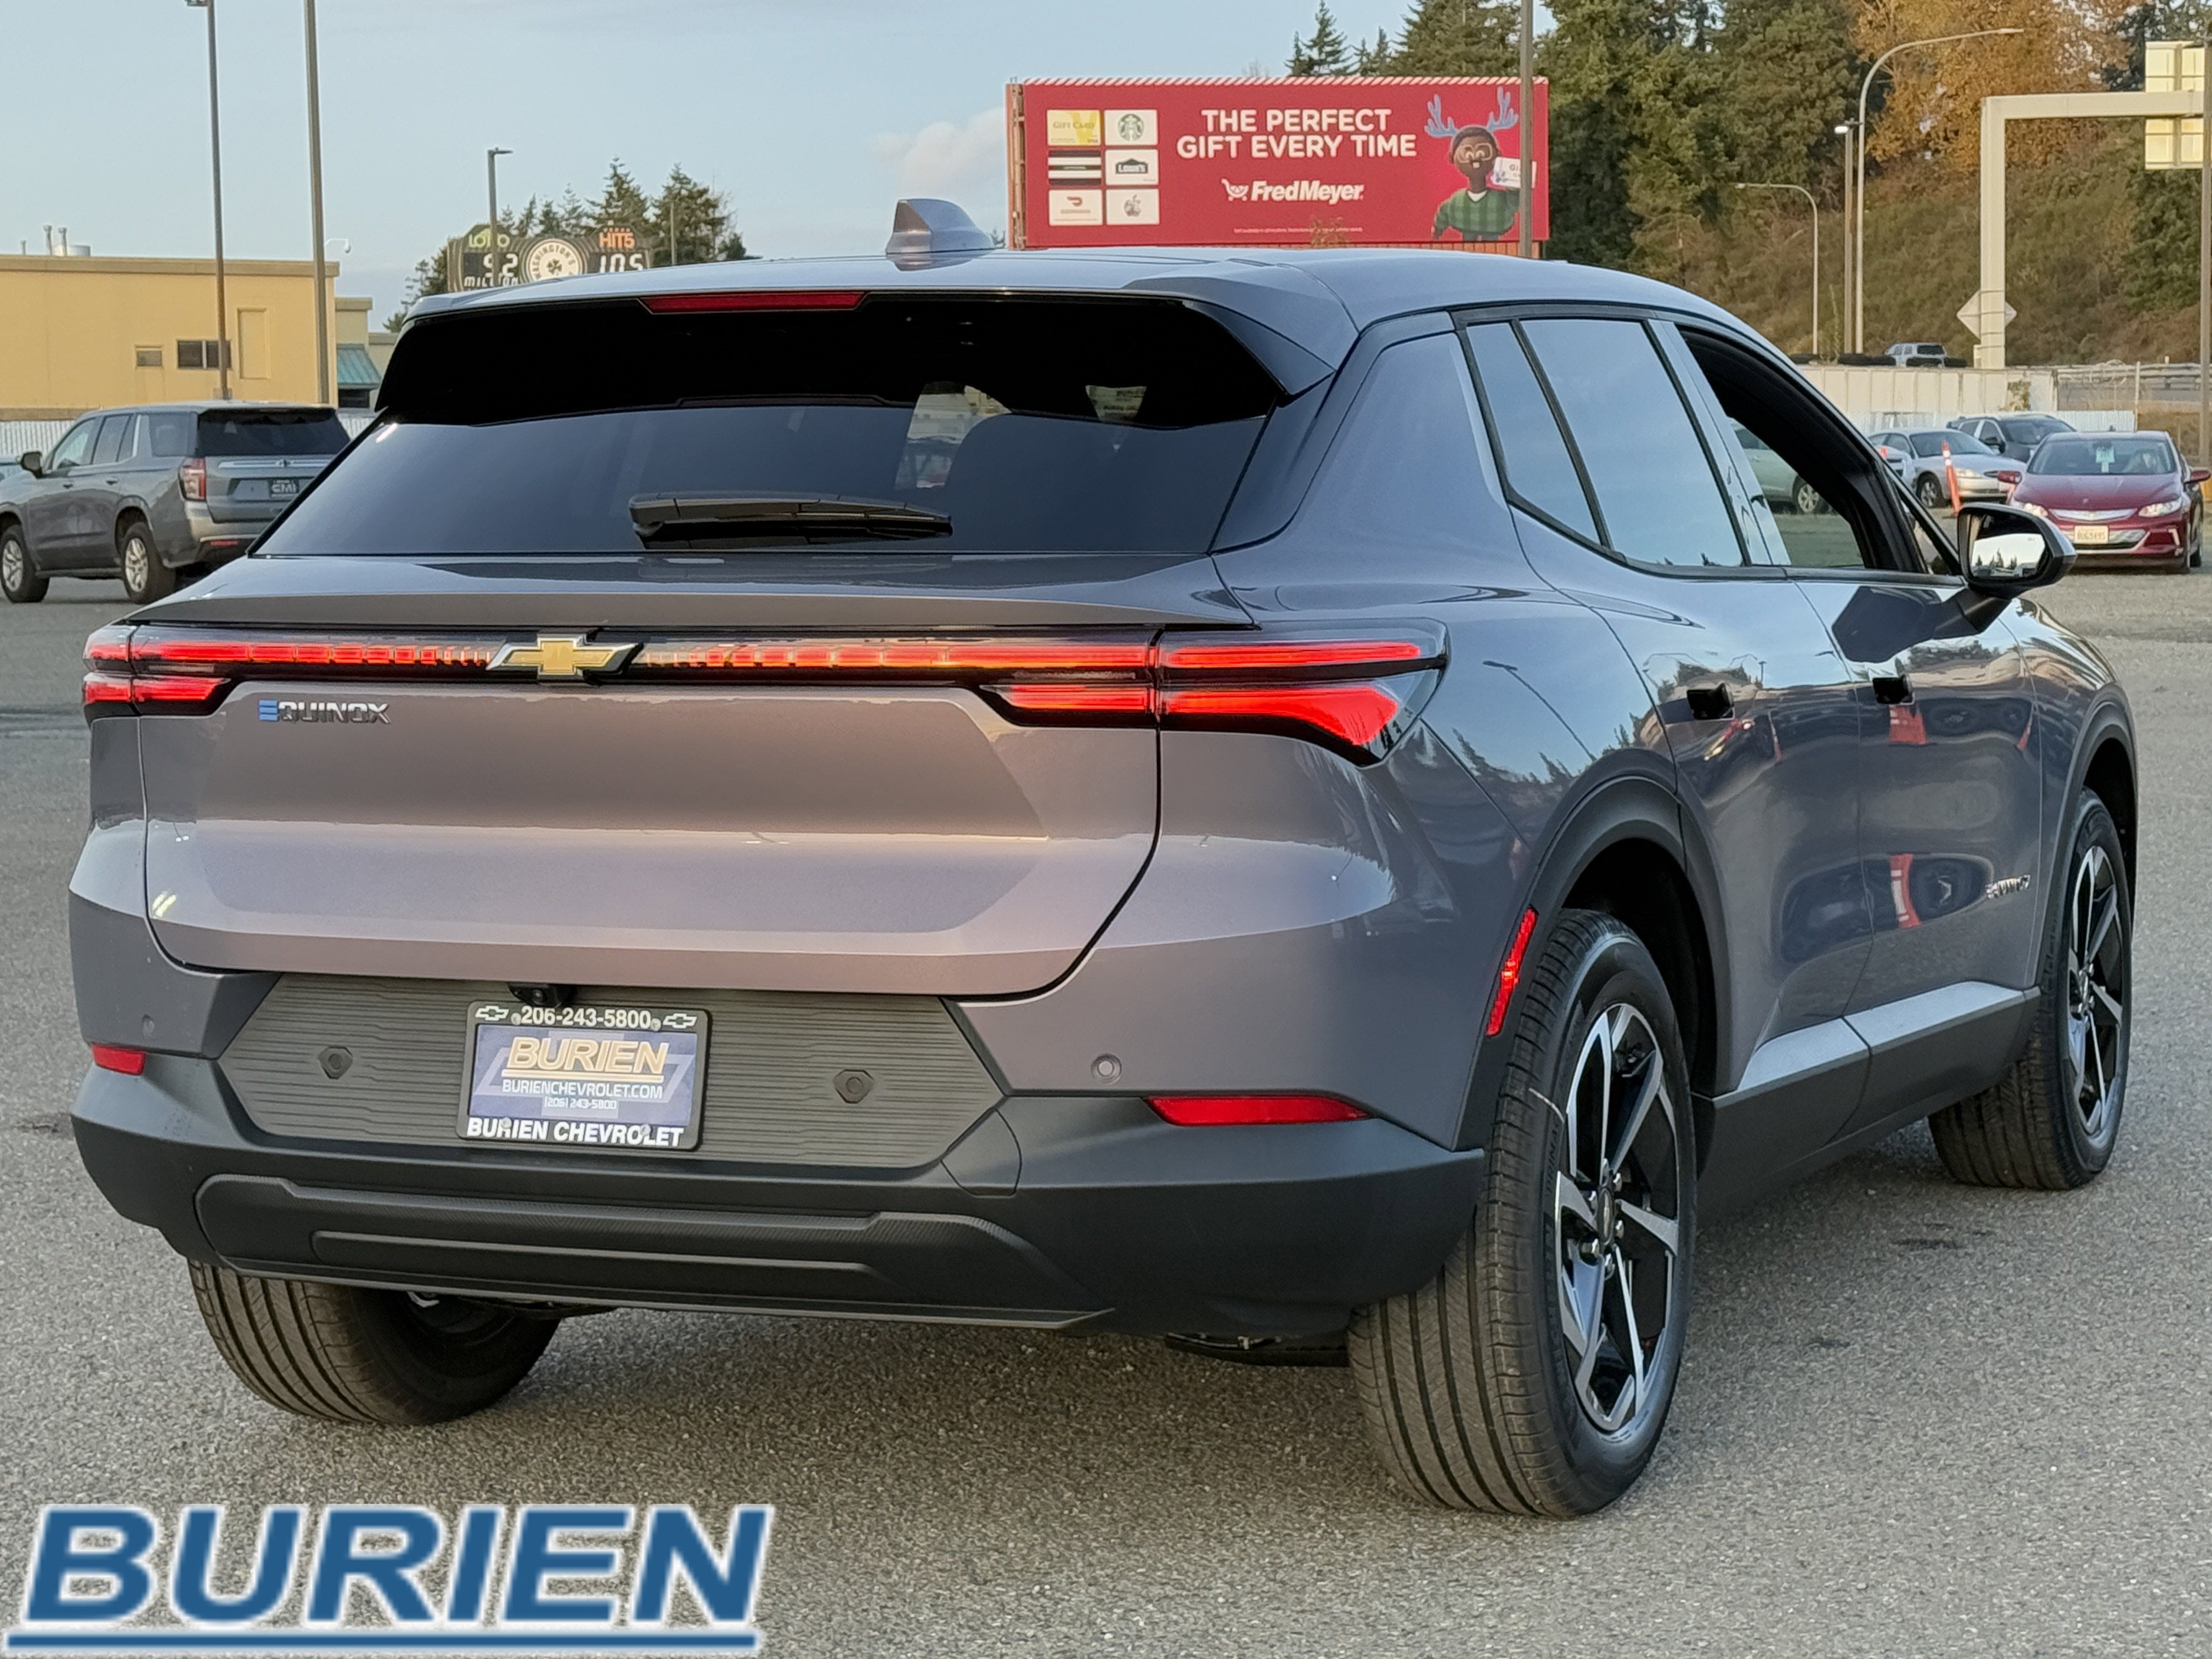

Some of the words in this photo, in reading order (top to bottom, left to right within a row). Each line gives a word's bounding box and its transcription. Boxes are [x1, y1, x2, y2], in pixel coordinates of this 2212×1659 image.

[1201, 109, 1257, 133] THE
[1266, 109, 1392, 133] PERFECT
[1176, 135, 1242, 159] GIFT
[1251, 134, 1343, 159] EVERY
[1350, 134, 1417, 157] TIME
[521, 1006, 652, 1029] 206-243-5800
[506, 1036, 669, 1074] BURIEN
[502, 1079, 663, 1099] BURIENCHEVROLET.COM
[466, 1117, 549, 1139] BURIEN
[554, 1123, 685, 1147] CHEVROLET
